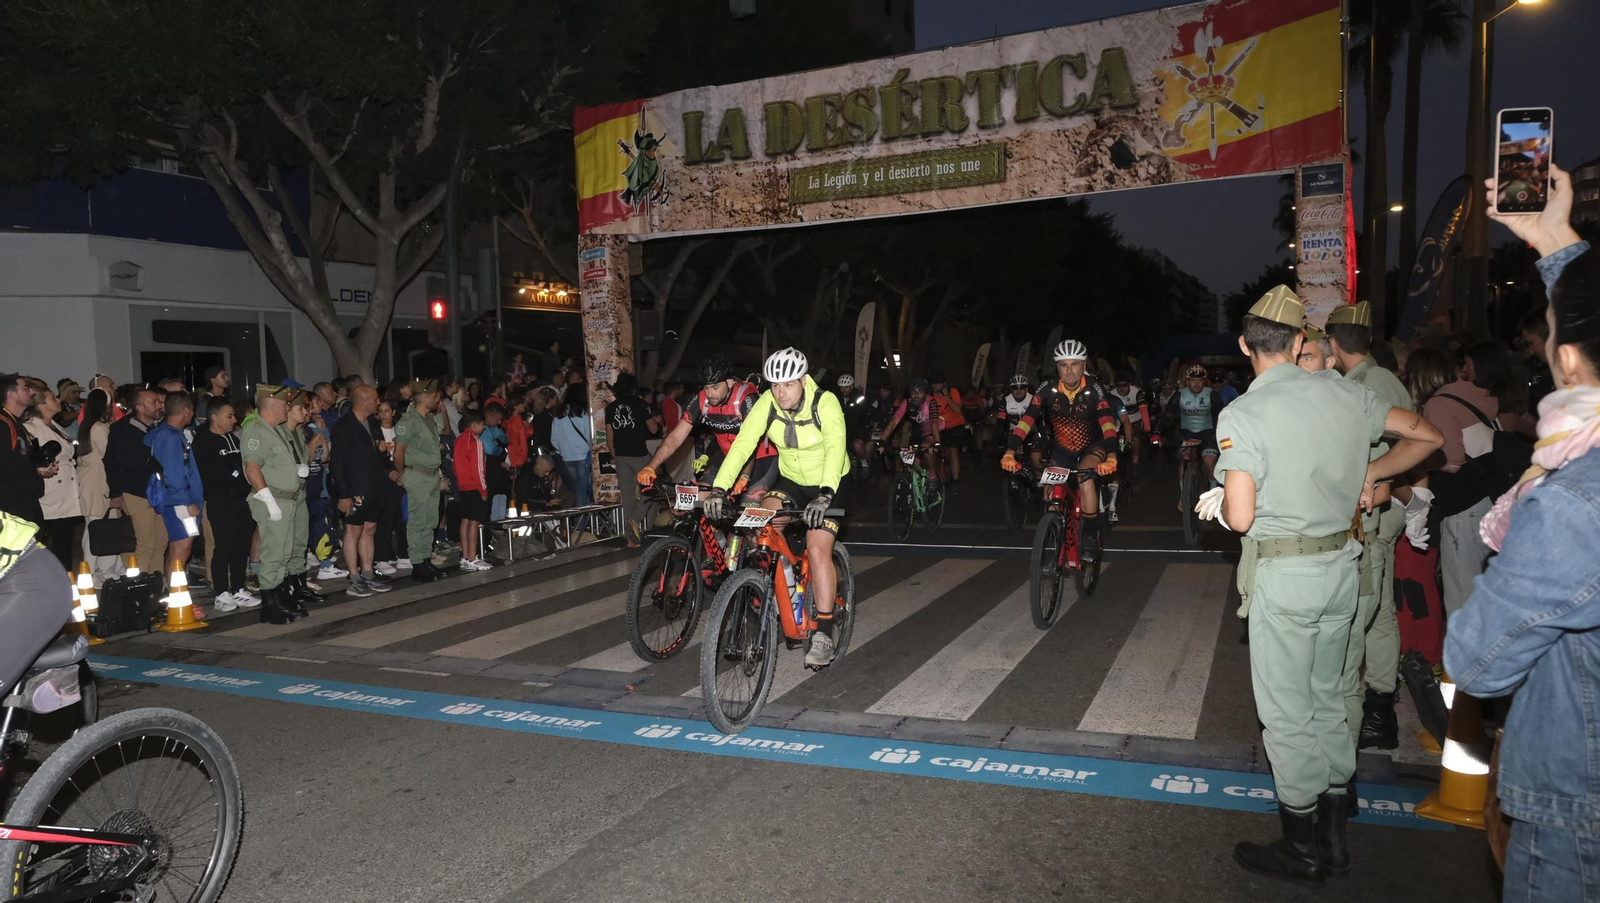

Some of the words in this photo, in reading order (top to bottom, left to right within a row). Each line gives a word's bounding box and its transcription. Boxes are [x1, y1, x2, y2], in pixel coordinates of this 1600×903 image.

[683, 107, 751, 164] LA
[763, 46, 1140, 157] DESÉRTICA
[808, 175, 821, 189] La
[824, 170, 858, 188] Legión
[862, 171, 870, 186] y
[874, 167, 885, 182] el
[888, 161, 931, 180] desierto
[936, 159, 955, 175] nos
[961, 158, 981, 173] une
[1303, 230, 1341, 239] GRUPO
[1303, 238, 1342, 249] RENTA
[1046, 472, 1066, 481] 7227
[680, 493, 697, 504] 6697
[313, 690, 417, 706] cajamar
[483, 710, 602, 728] cajamar
[685, 732, 825, 753] cajamar
[929, 757, 1099, 780] cajamar
[1043, 776, 1089, 786] RURAL
